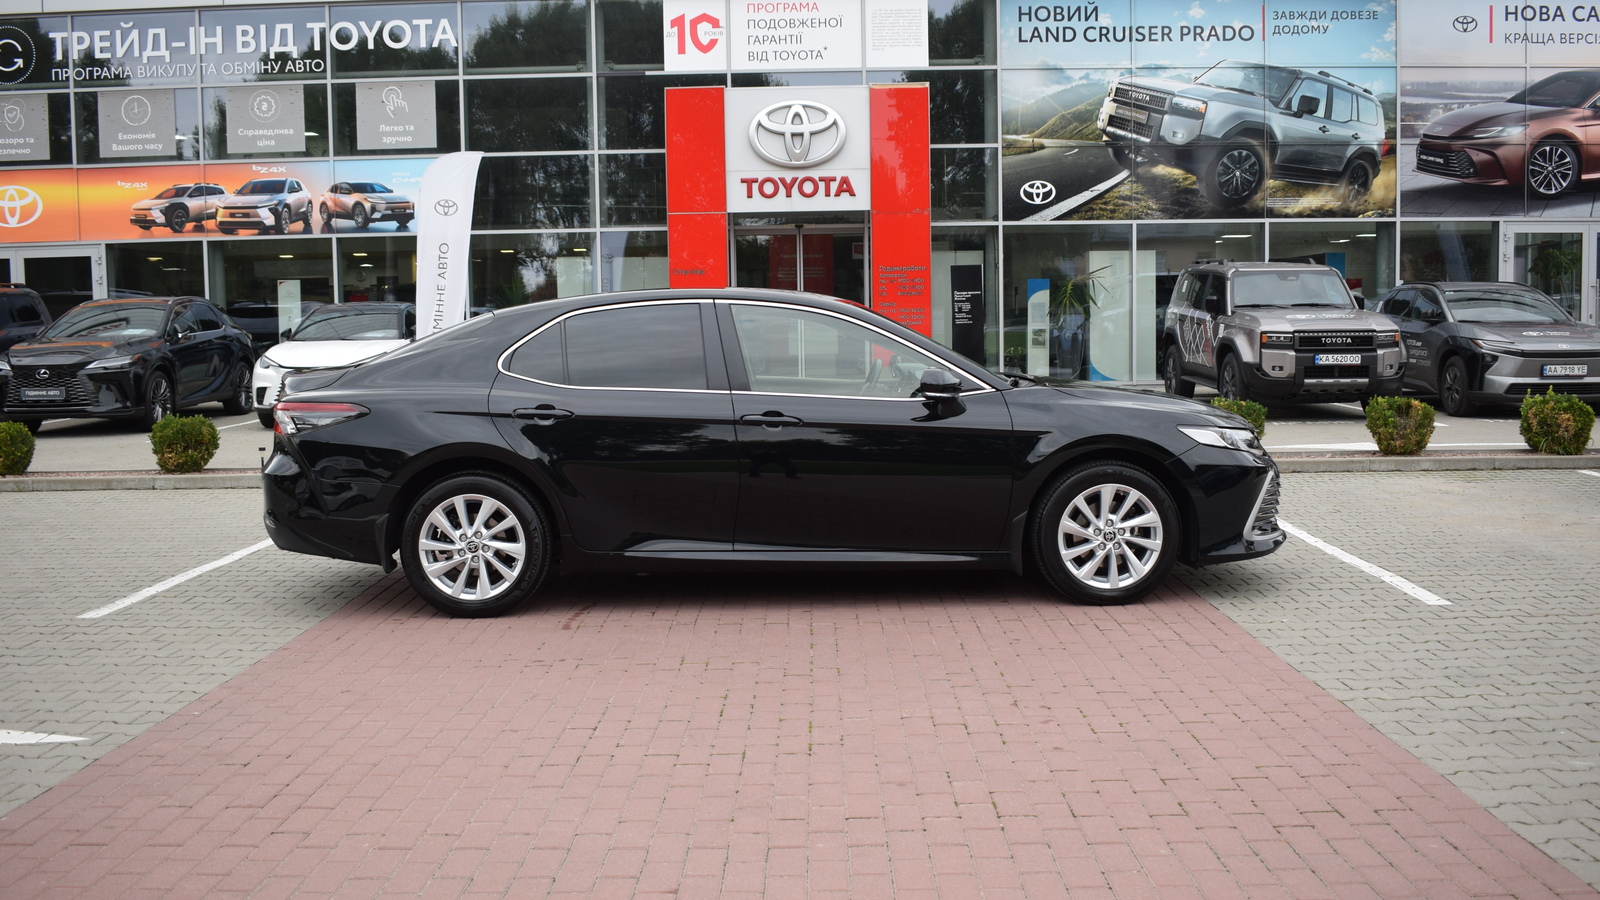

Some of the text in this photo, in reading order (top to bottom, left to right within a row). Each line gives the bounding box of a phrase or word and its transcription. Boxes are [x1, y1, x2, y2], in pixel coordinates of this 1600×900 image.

[746, 2, 820, 14] ПРОГРАМА
[1017, 1, 1100, 22] НОВИЙ
[1504, 5, 1566, 22] НОВА
[1272, 10, 1379, 22] ЗАВЖДИ ДОВЕЗЕ
[747, 15, 844, 31] ПОДОВЖЕНОЇ
[1017, 25, 1255, 43] LAND CRUISER PRADO
[1272, 24, 1330, 36] ДОДОМУ
[49, 18, 458, 63] ТРЕЙД-ІН ВІД TOYOTA
[747, 32, 803, 45] ГАРАНТІЇ
[1504, 33, 1556, 46] КРАЩА
[748, 51, 770, 63] ВІД
[52, 59, 325, 81] ПРОГРАМА ВИКУПУ ТА ОБМІНУ АВТО
[1128, 91, 1150, 101] TOYOTA
[237, 128, 294, 137] Справедлива
[378, 124, 415, 132] Легко та
[118, 131, 156, 140] Економія
[381, 136, 413, 144] зручно
[112, 142, 163, 151] Вашого часу
[256, 138, 276, 147] ціна
[740, 175, 857, 199] TOYOTA
[432, 242, 450, 334] МІННЕ АВТО
[1319, 355, 1330, 363] KA
[1331, 355, 1349, 363] 5620
[1547, 365, 1586, 374] AA 7918 YE
